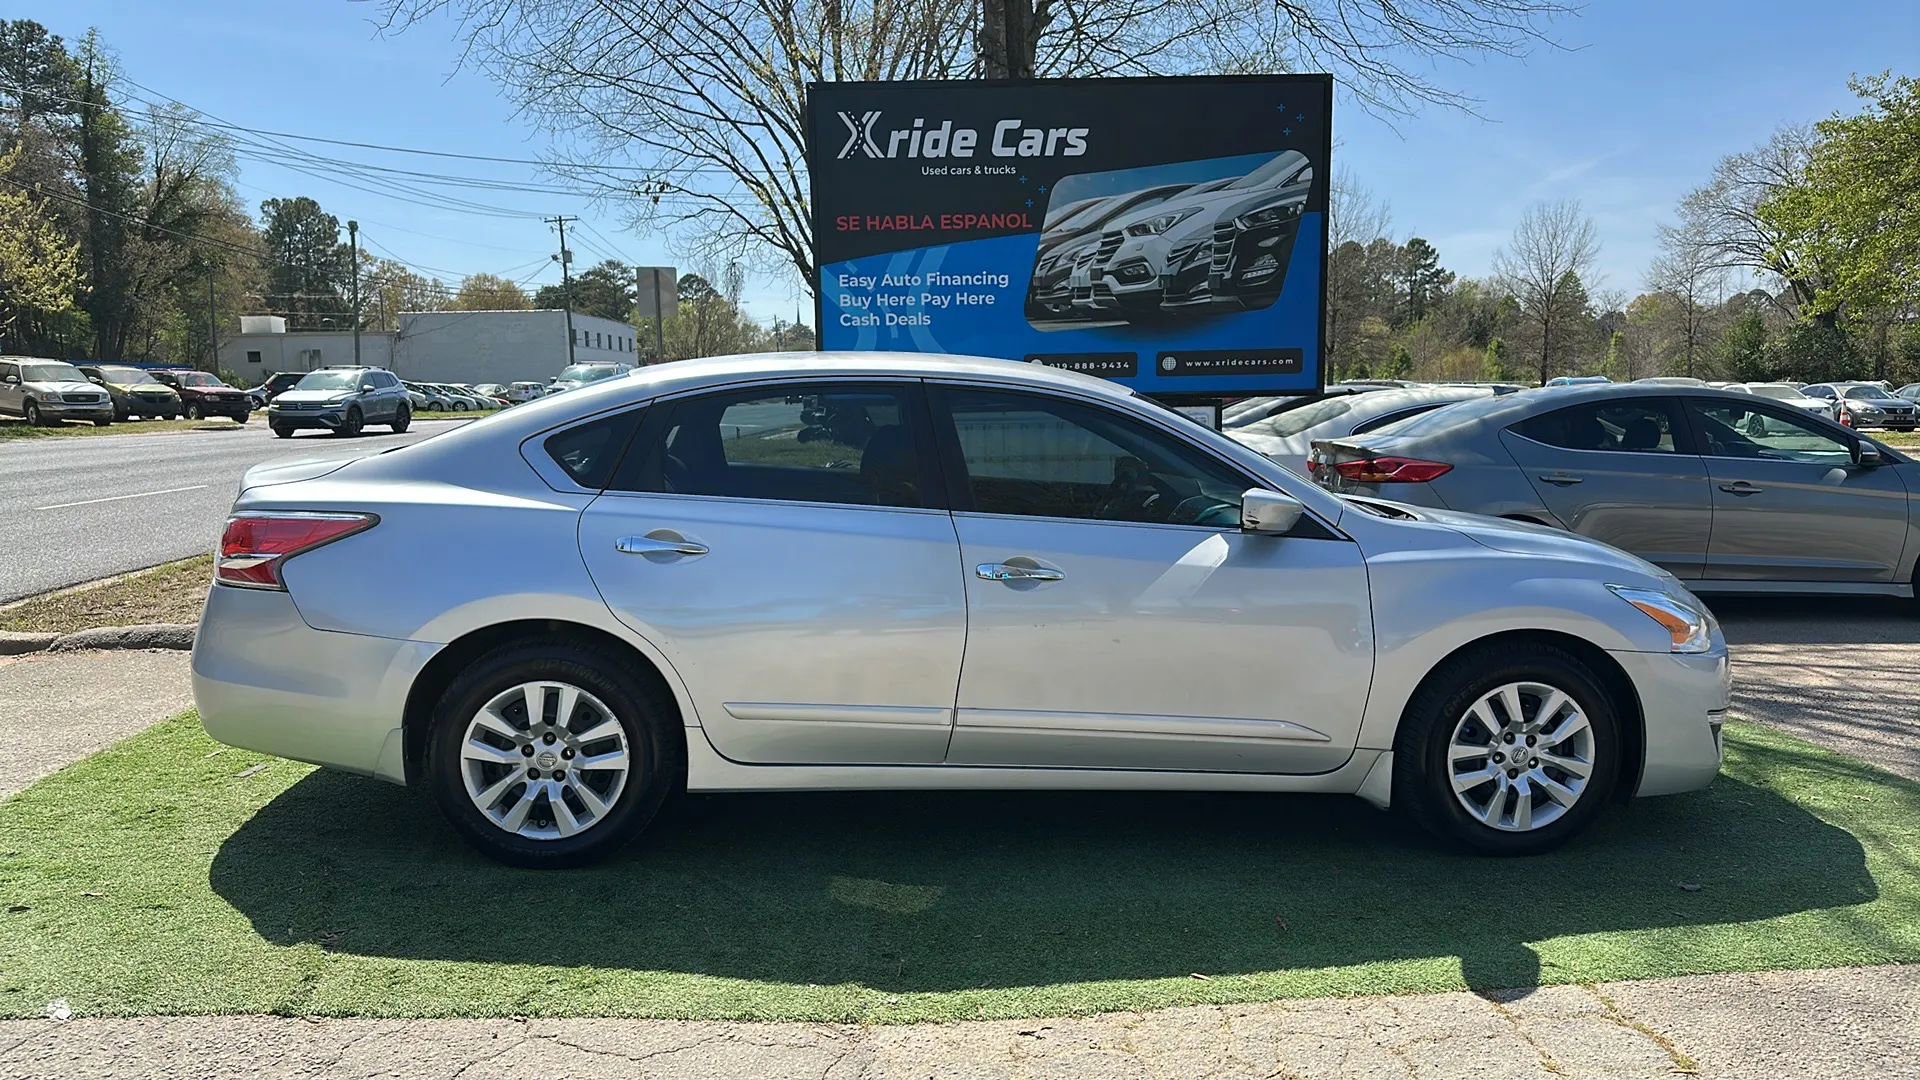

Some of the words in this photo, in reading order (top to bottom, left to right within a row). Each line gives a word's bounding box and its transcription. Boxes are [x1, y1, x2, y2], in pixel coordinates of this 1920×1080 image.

[991, 119, 1090, 157] Cars
[921, 166, 948, 175] Used
[950, 167, 972, 175] cars
[974, 166, 982, 175] &
[984, 165, 1016, 175] trucks
[836, 216, 860, 231] SE
[866, 215, 935, 231] HABLA
[940, 213, 1033, 230] ESPANOL
[839, 274, 877, 290] Easy
[881, 273, 921, 287] Auto
[926, 271, 1009, 288] Financing
[839, 295, 872, 309] Buy
[876, 294, 916, 307] Here
[921, 293, 951, 308] Pay
[956, 292, 995, 305] Here
[839, 313, 880, 327] Cash
[885, 312, 931, 326] Deals
[1185, 358, 1294, 367] www.xridecars.com
